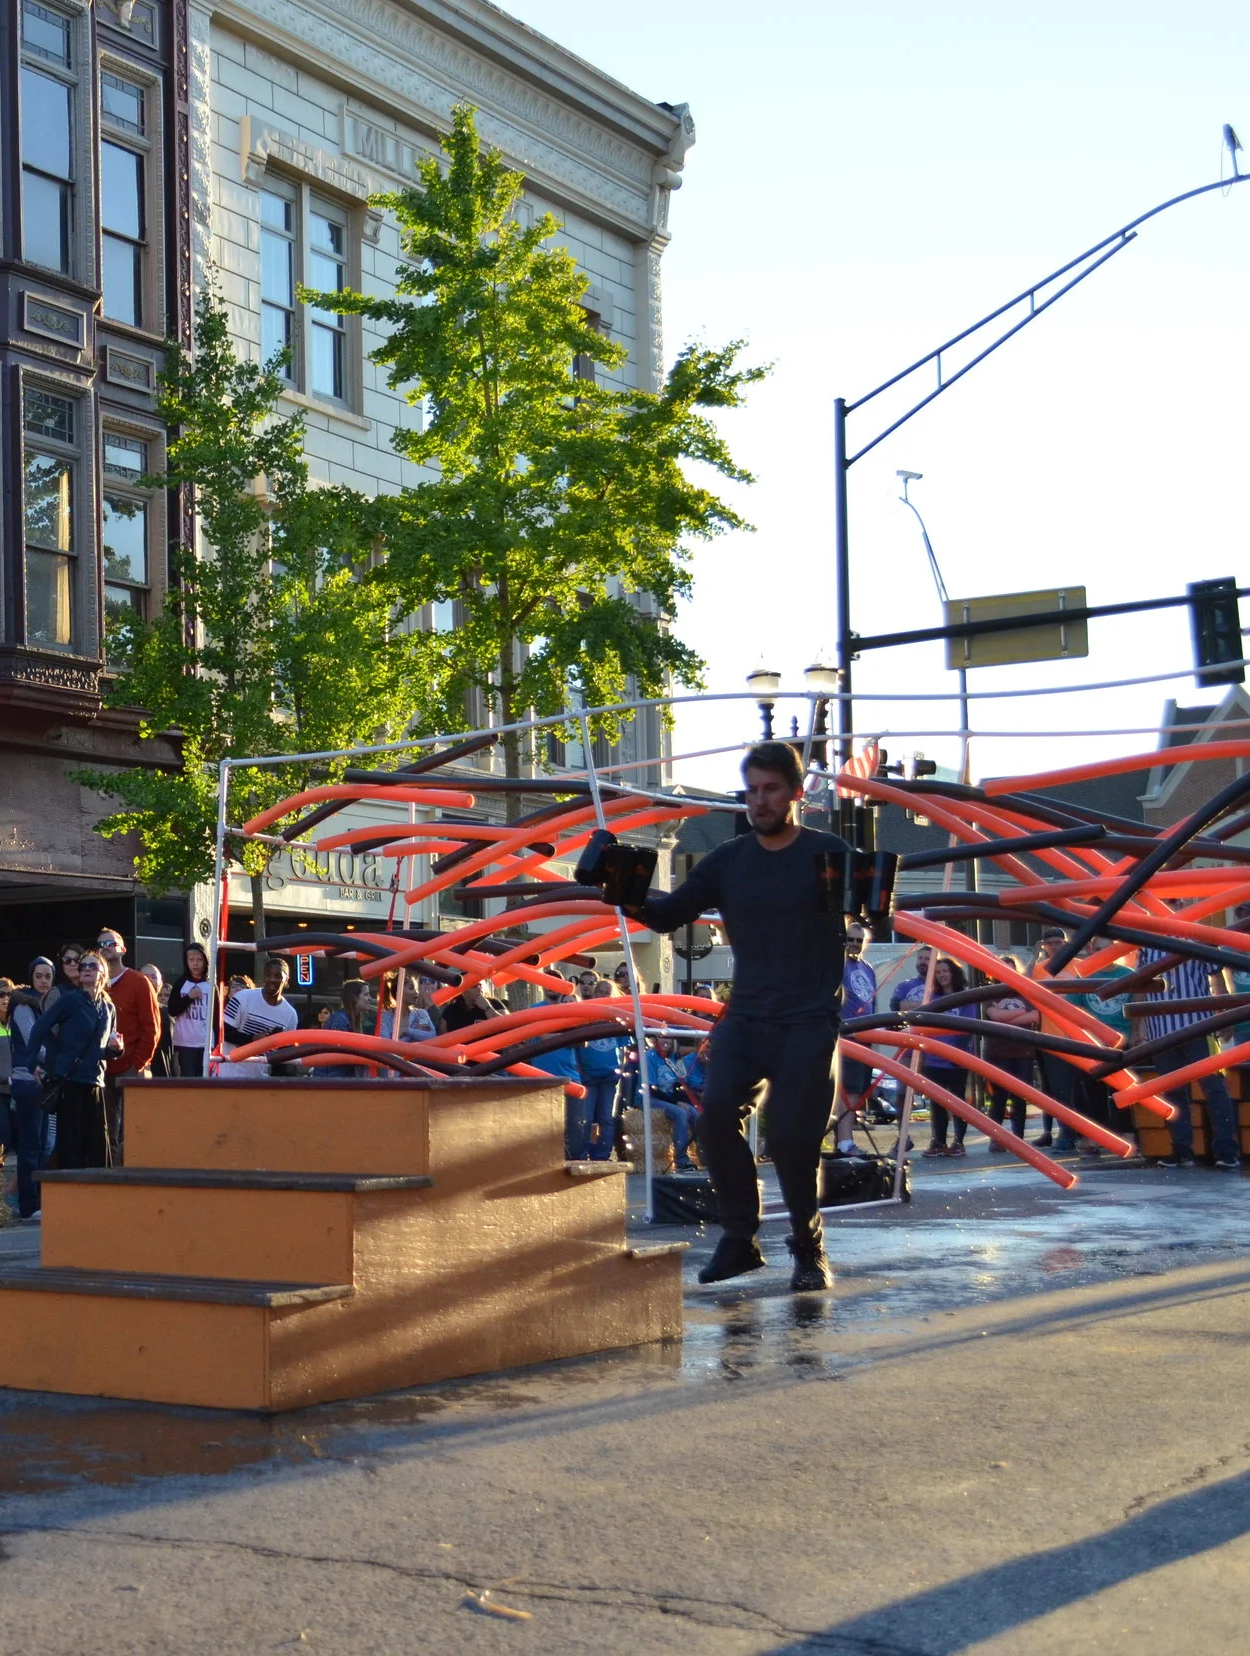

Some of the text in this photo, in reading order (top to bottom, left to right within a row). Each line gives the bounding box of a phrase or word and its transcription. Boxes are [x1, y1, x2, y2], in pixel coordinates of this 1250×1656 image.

[339, 887, 383, 903] BAR & GRILL
[300, 954, 310, 983] PEN
